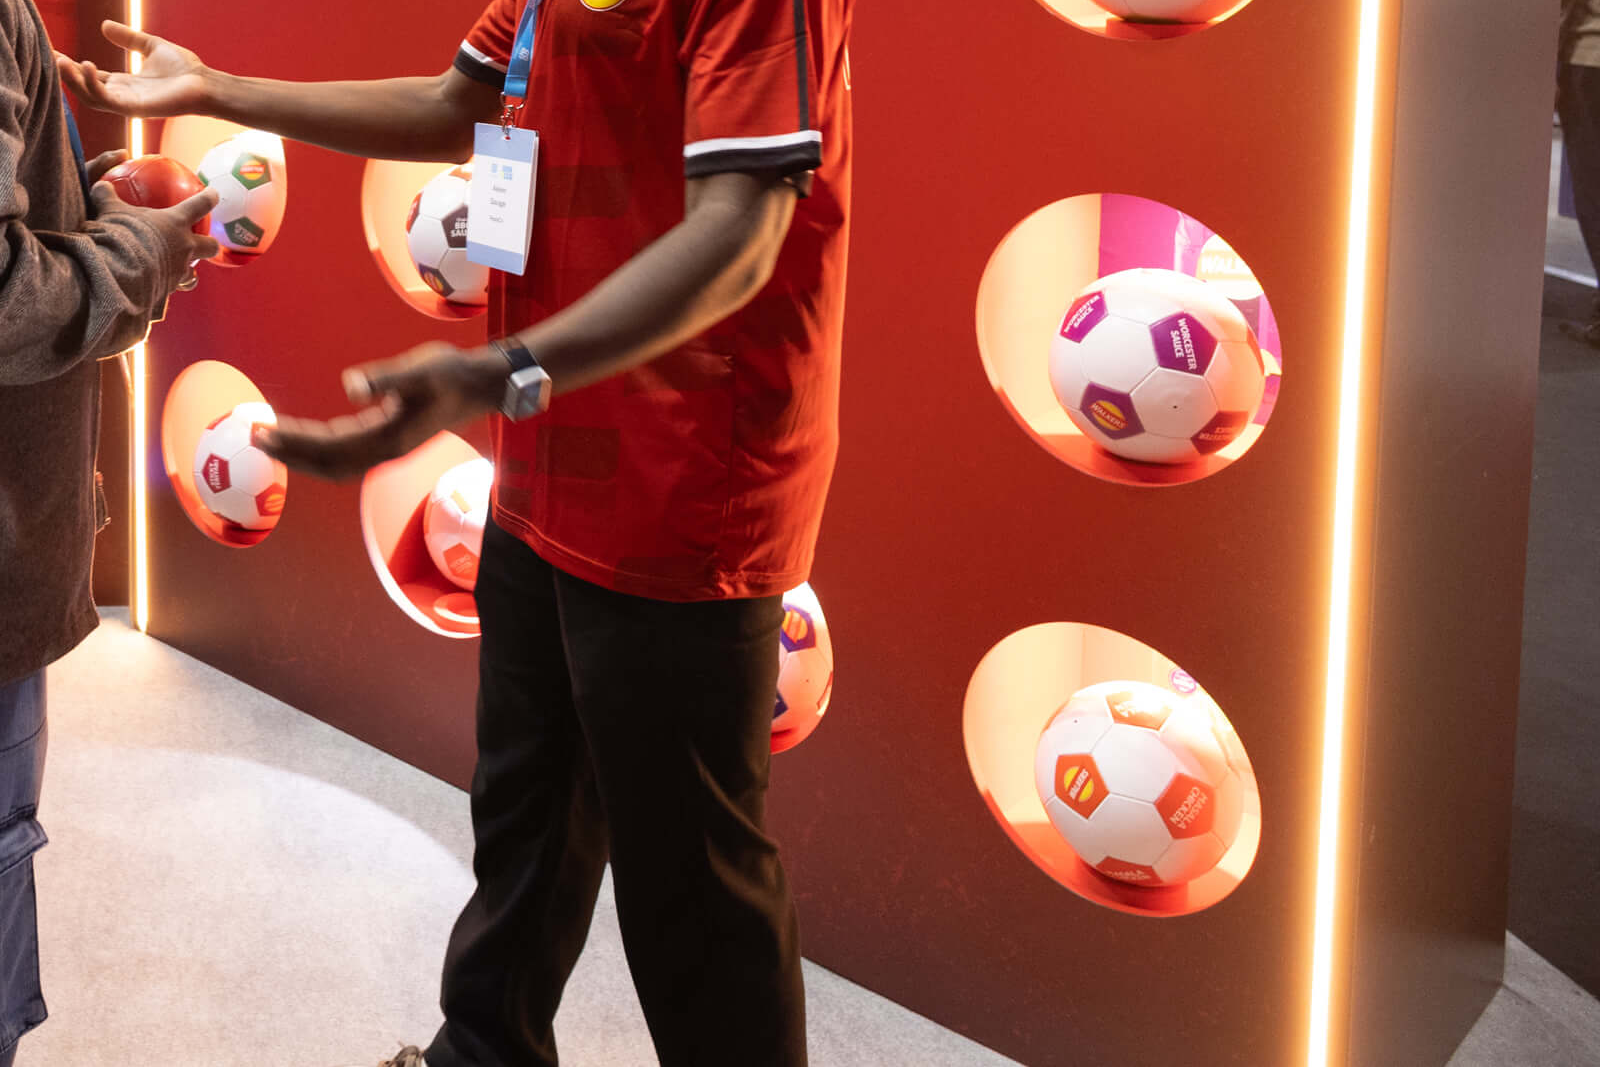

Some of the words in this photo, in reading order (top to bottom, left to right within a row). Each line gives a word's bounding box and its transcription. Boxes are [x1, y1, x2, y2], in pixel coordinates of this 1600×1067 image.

[1170, 330, 1185, 359] SAUCE
[1177, 318, 1198, 371] WORCESTER
[1091, 403, 1127, 430] WALKERS
[1169, 786, 1200, 824] CHICKEN
[1178, 790, 1208, 829] MASALA
